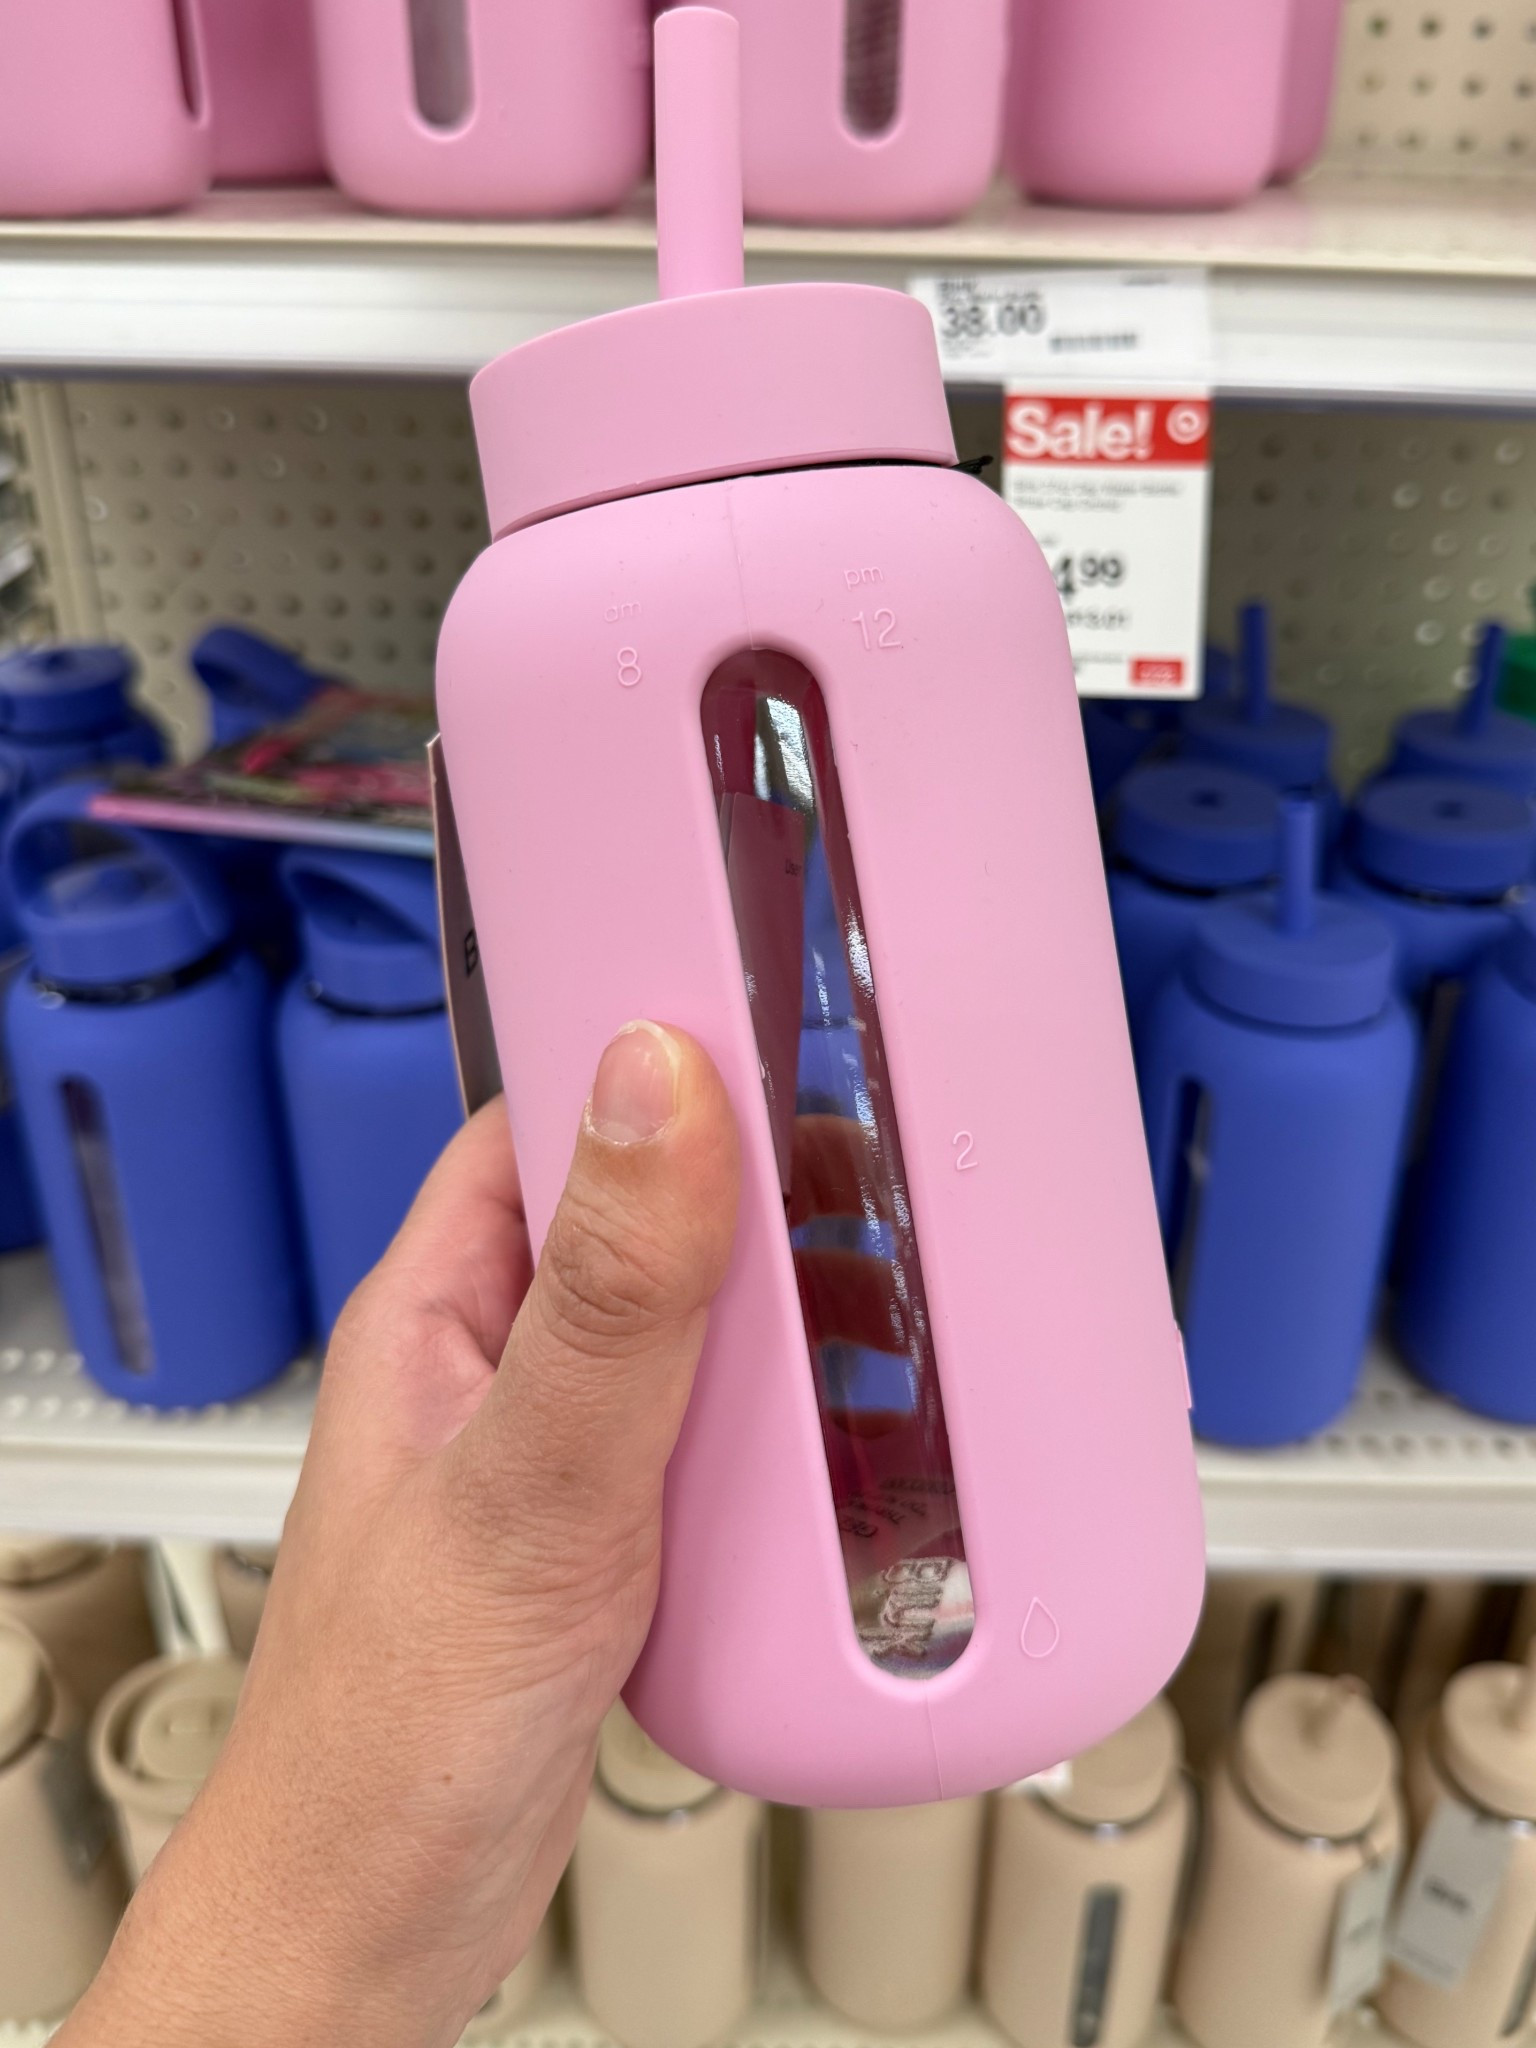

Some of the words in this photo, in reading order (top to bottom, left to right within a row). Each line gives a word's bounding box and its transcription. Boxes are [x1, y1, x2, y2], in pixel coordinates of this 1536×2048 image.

[1007, 402, 1154, 460] Sale!
[844, 566, 883, 590] pm
[604, 601, 642, 624] am
[851, 608, 901, 650] 12
[616, 646, 642, 687] 8
[952, 1130, 979, 1171] 2
